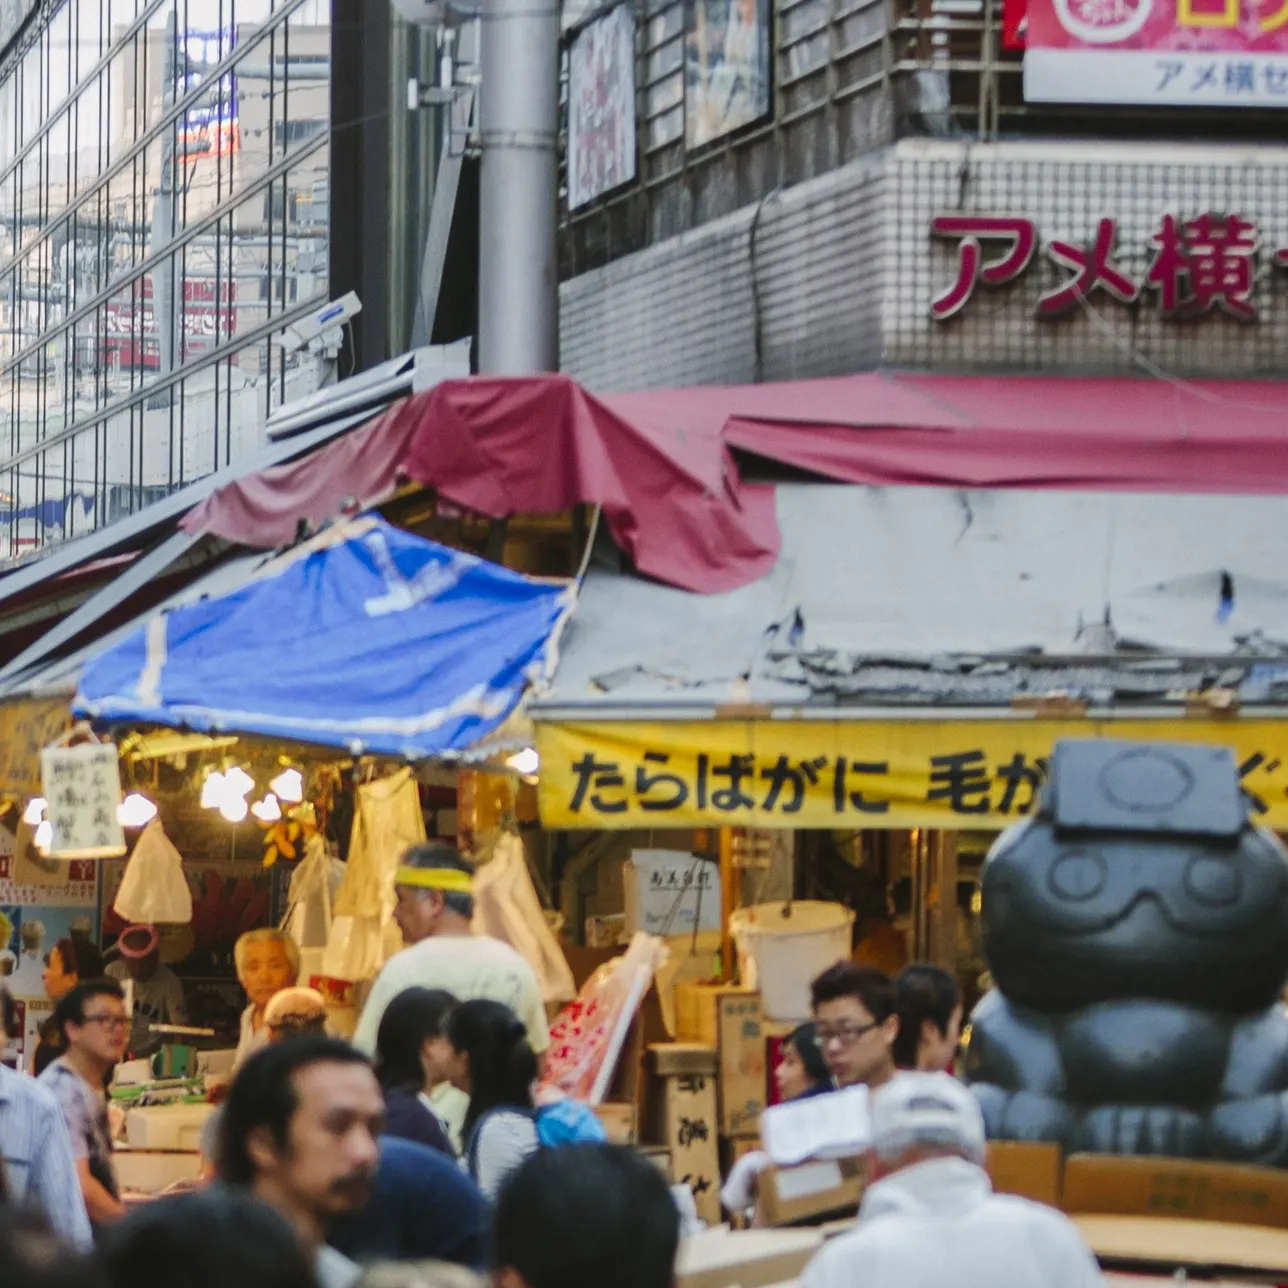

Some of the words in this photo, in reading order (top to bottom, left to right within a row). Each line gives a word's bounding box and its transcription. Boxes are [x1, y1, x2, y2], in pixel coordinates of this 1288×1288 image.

[930, 212, 1288, 318] アメ横
[568, 751, 891, 814] たらばがに
